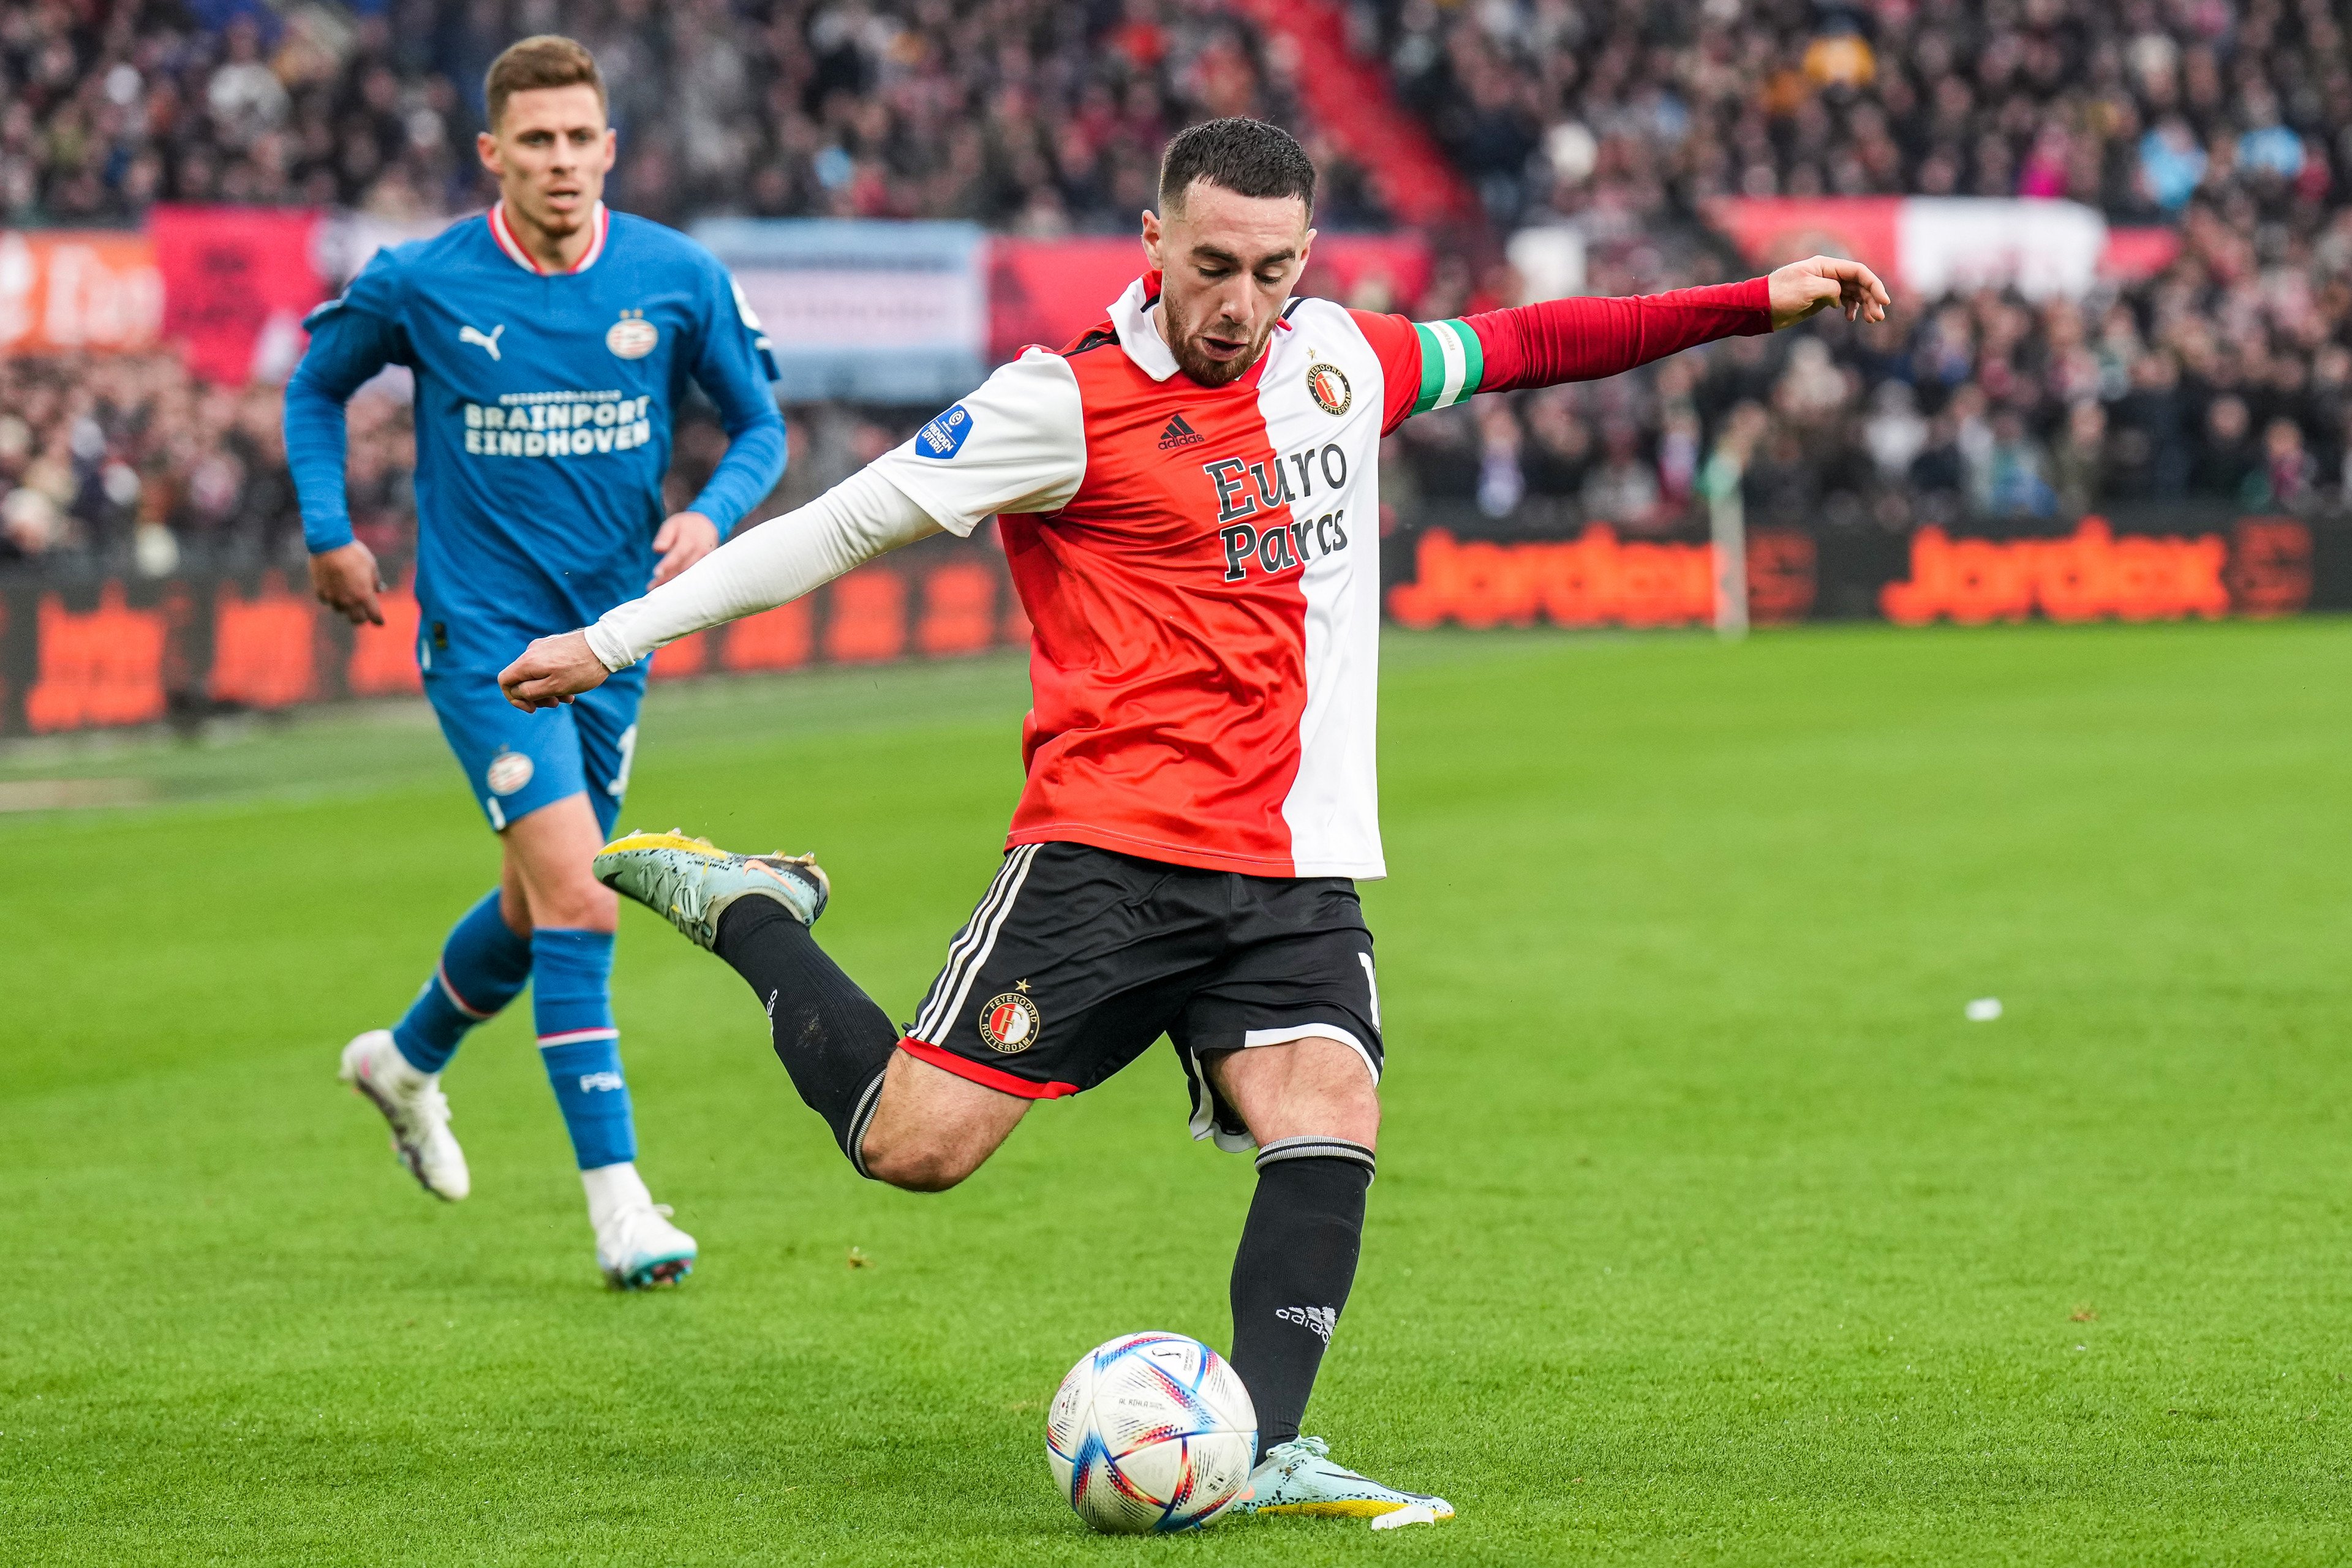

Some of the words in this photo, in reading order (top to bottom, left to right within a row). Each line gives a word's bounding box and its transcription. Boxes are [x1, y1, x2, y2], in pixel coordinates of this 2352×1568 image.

[1308, 364, 1342, 387] FEYENOORD
[464, 395, 650, 431] BRAINPORT
[1318, 391, 1352, 415] ROTTERDAM
[465, 418, 650, 457] EINDHOVEN
[921, 429, 944, 453] LOTERIJ
[927, 421, 954, 452] VRIENDEN
[1158, 434, 1205, 450] adidas
[1203, 443, 1347, 524] Euro
[1219, 509, 1348, 582] Parcs
[989, 995, 1038, 1023] FEYENOORD
[981, 1023, 1031, 1052] ROTTERDAM
[1275, 1308, 1330, 1351] adida
